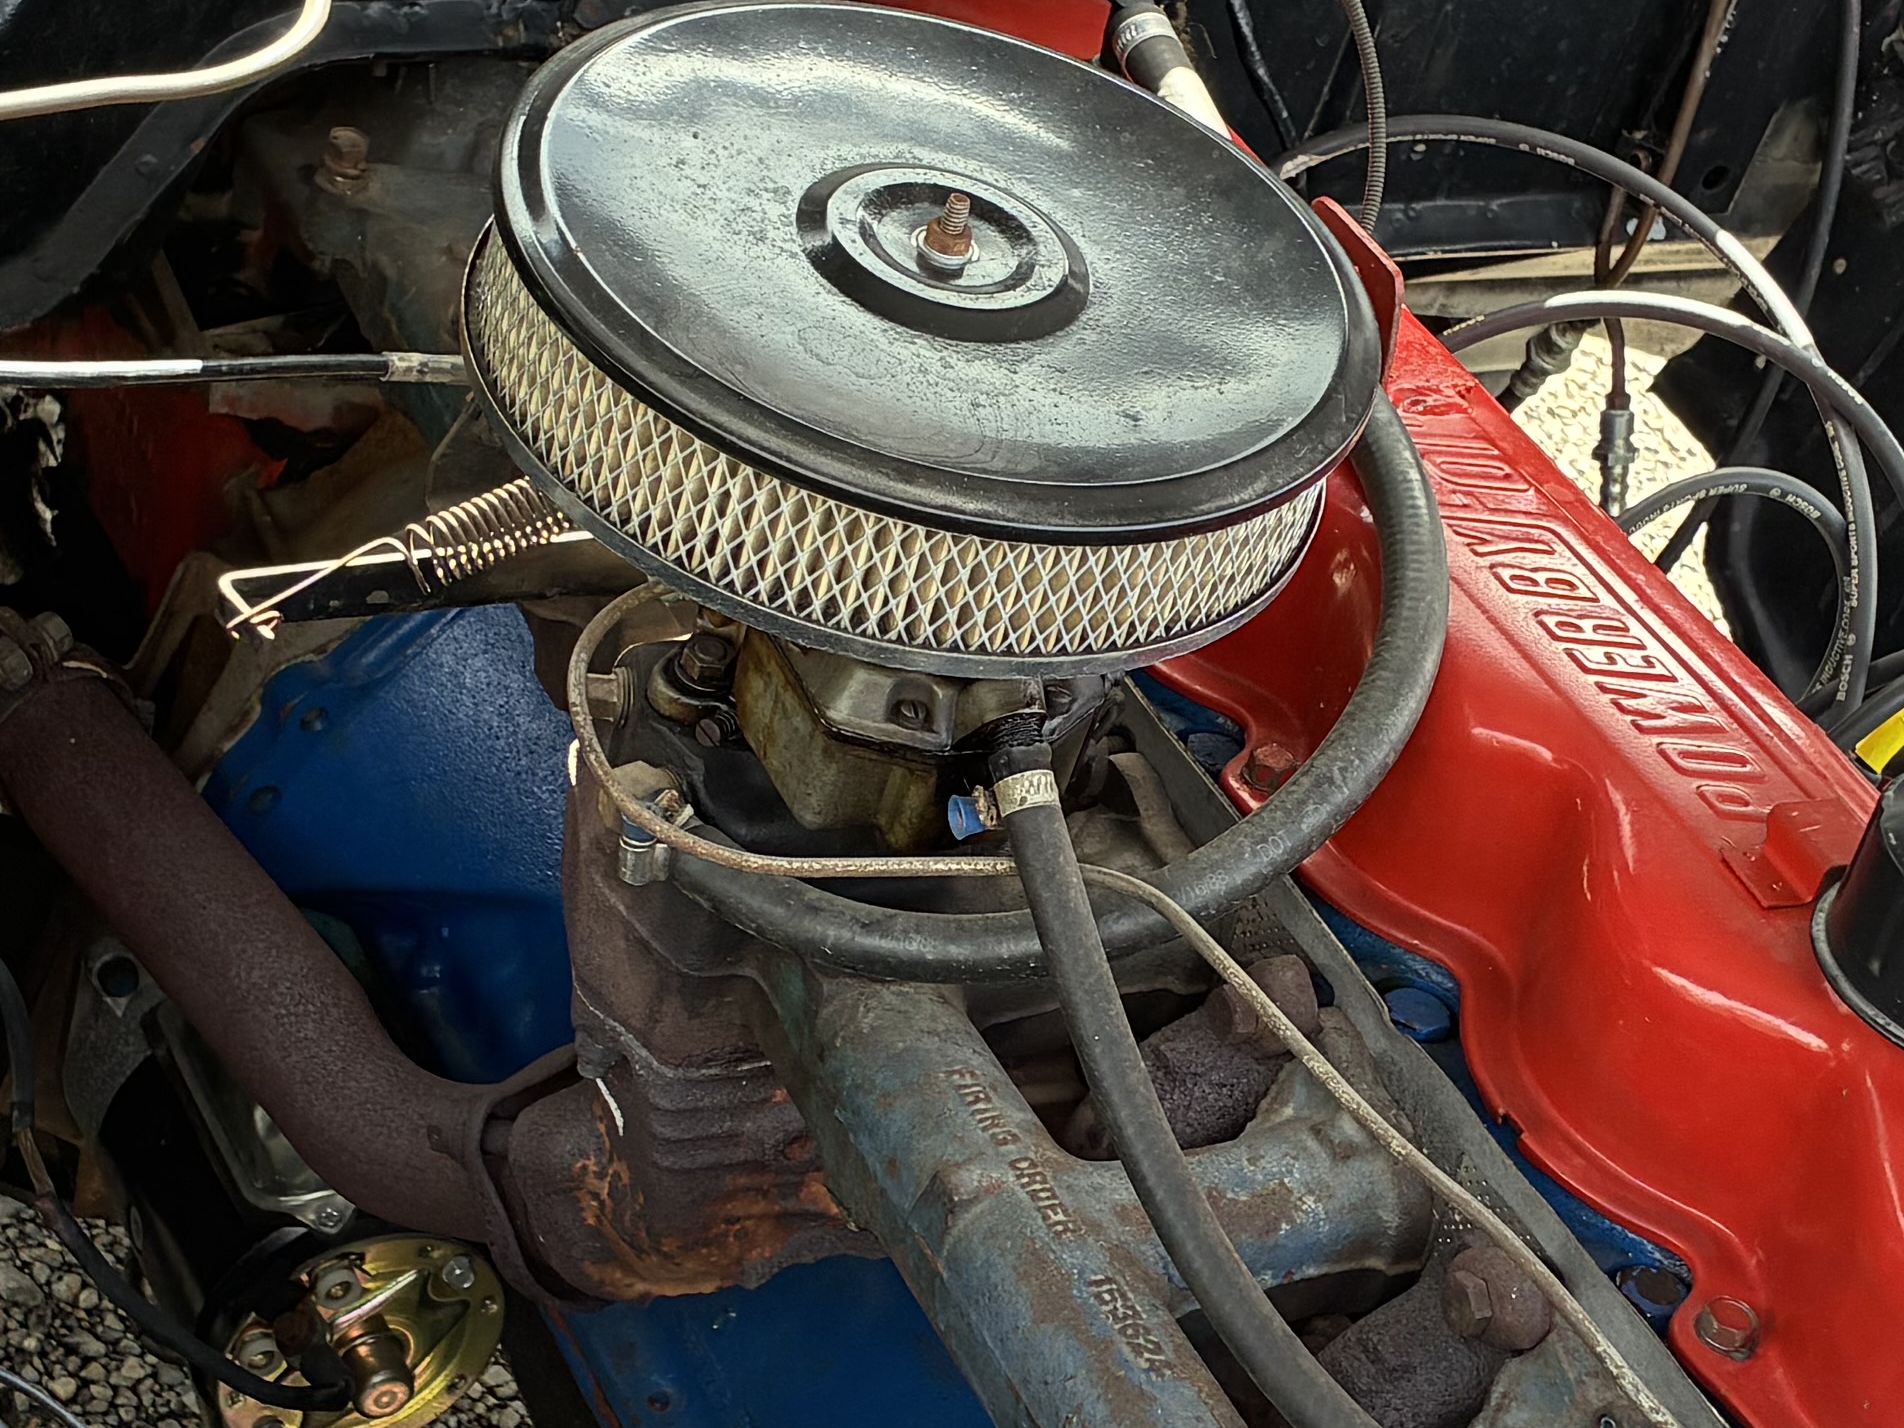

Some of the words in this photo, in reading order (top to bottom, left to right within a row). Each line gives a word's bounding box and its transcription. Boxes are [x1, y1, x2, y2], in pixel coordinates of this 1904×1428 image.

[1708, 483, 1747, 499] SUPER
[1785, 493, 1822, 520] BOSCH
[1450, 526, 1602, 606] BY
[1819, 629, 1847, 688] INDUCTIVE
[1836, 655, 1853, 701] BOSCH
[1508, 608, 1768, 824] POWER
[1256, 831, 1293, 862] DOT
[946, 1068, 1023, 1147] FIRING
[1009, 1156, 1088, 1240] ORDER
